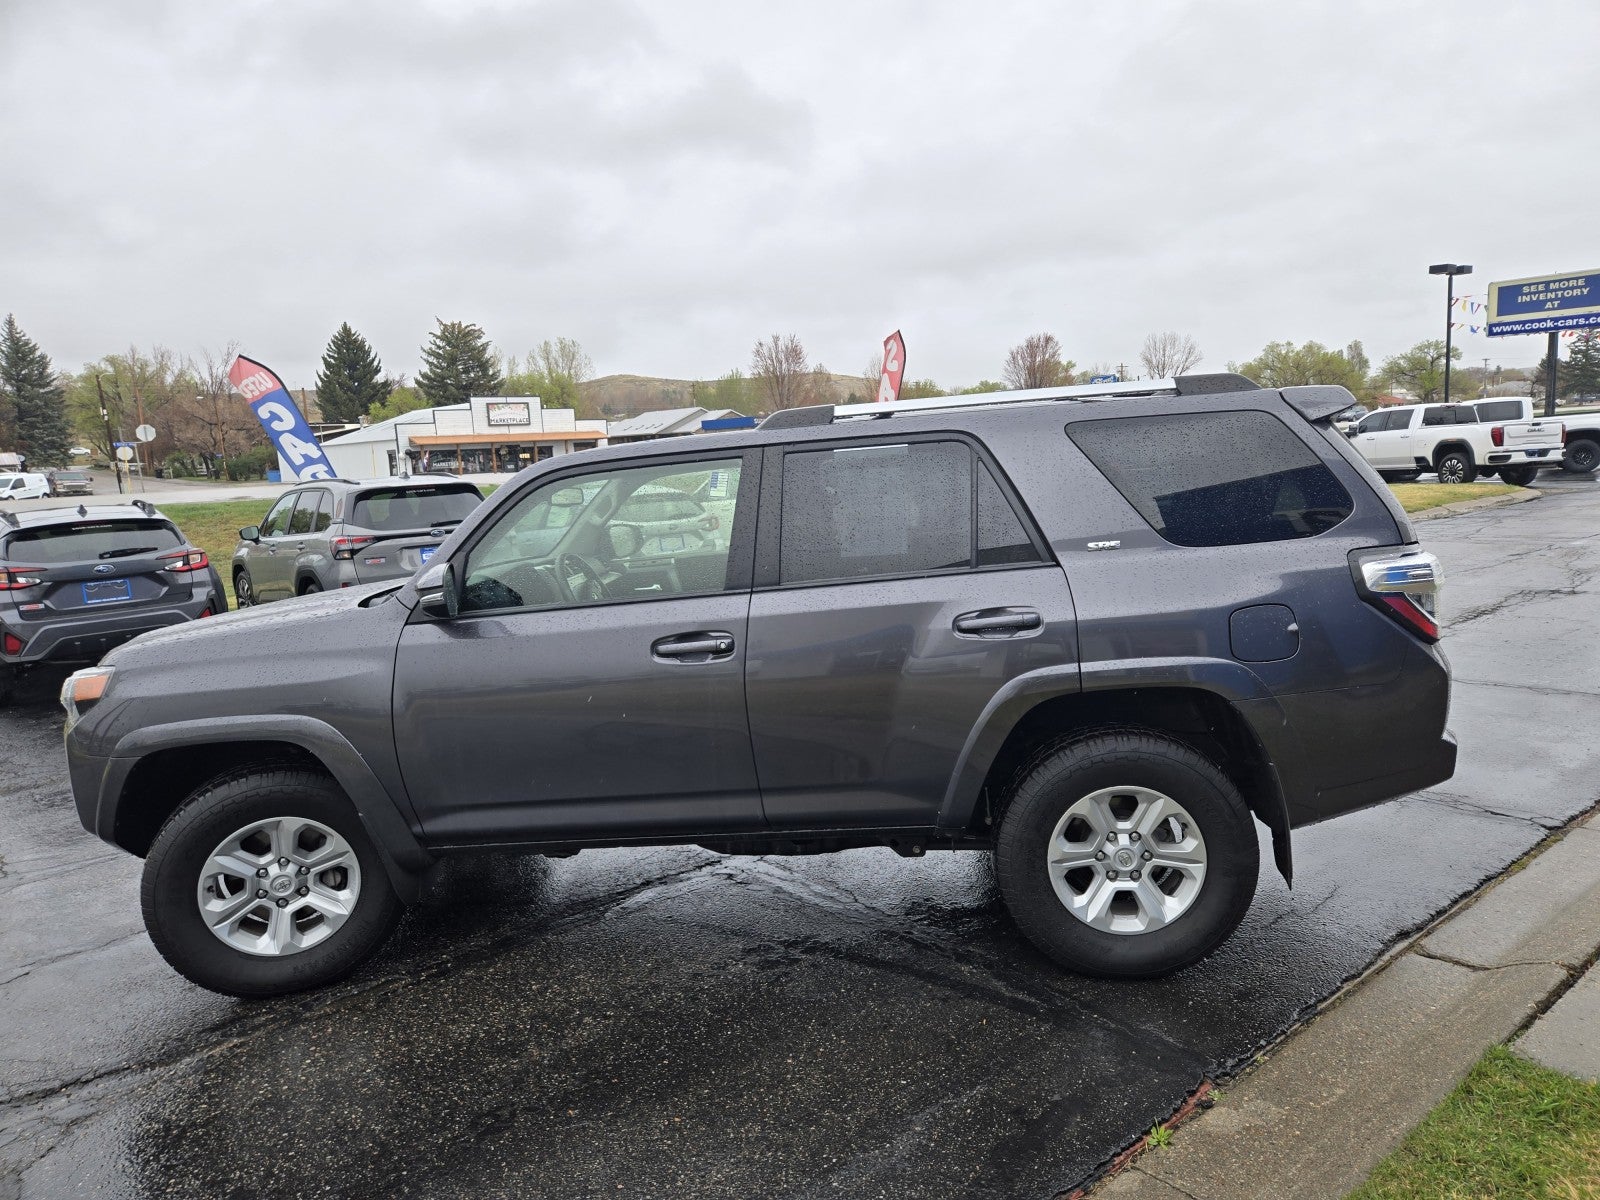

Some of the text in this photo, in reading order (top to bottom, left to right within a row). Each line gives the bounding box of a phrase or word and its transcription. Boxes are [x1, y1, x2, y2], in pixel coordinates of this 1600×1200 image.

[1522, 278, 1585, 293] SEE MORE
[1517, 287, 1590, 302] INVENTORY
[1544, 300, 1560, 309] AT
